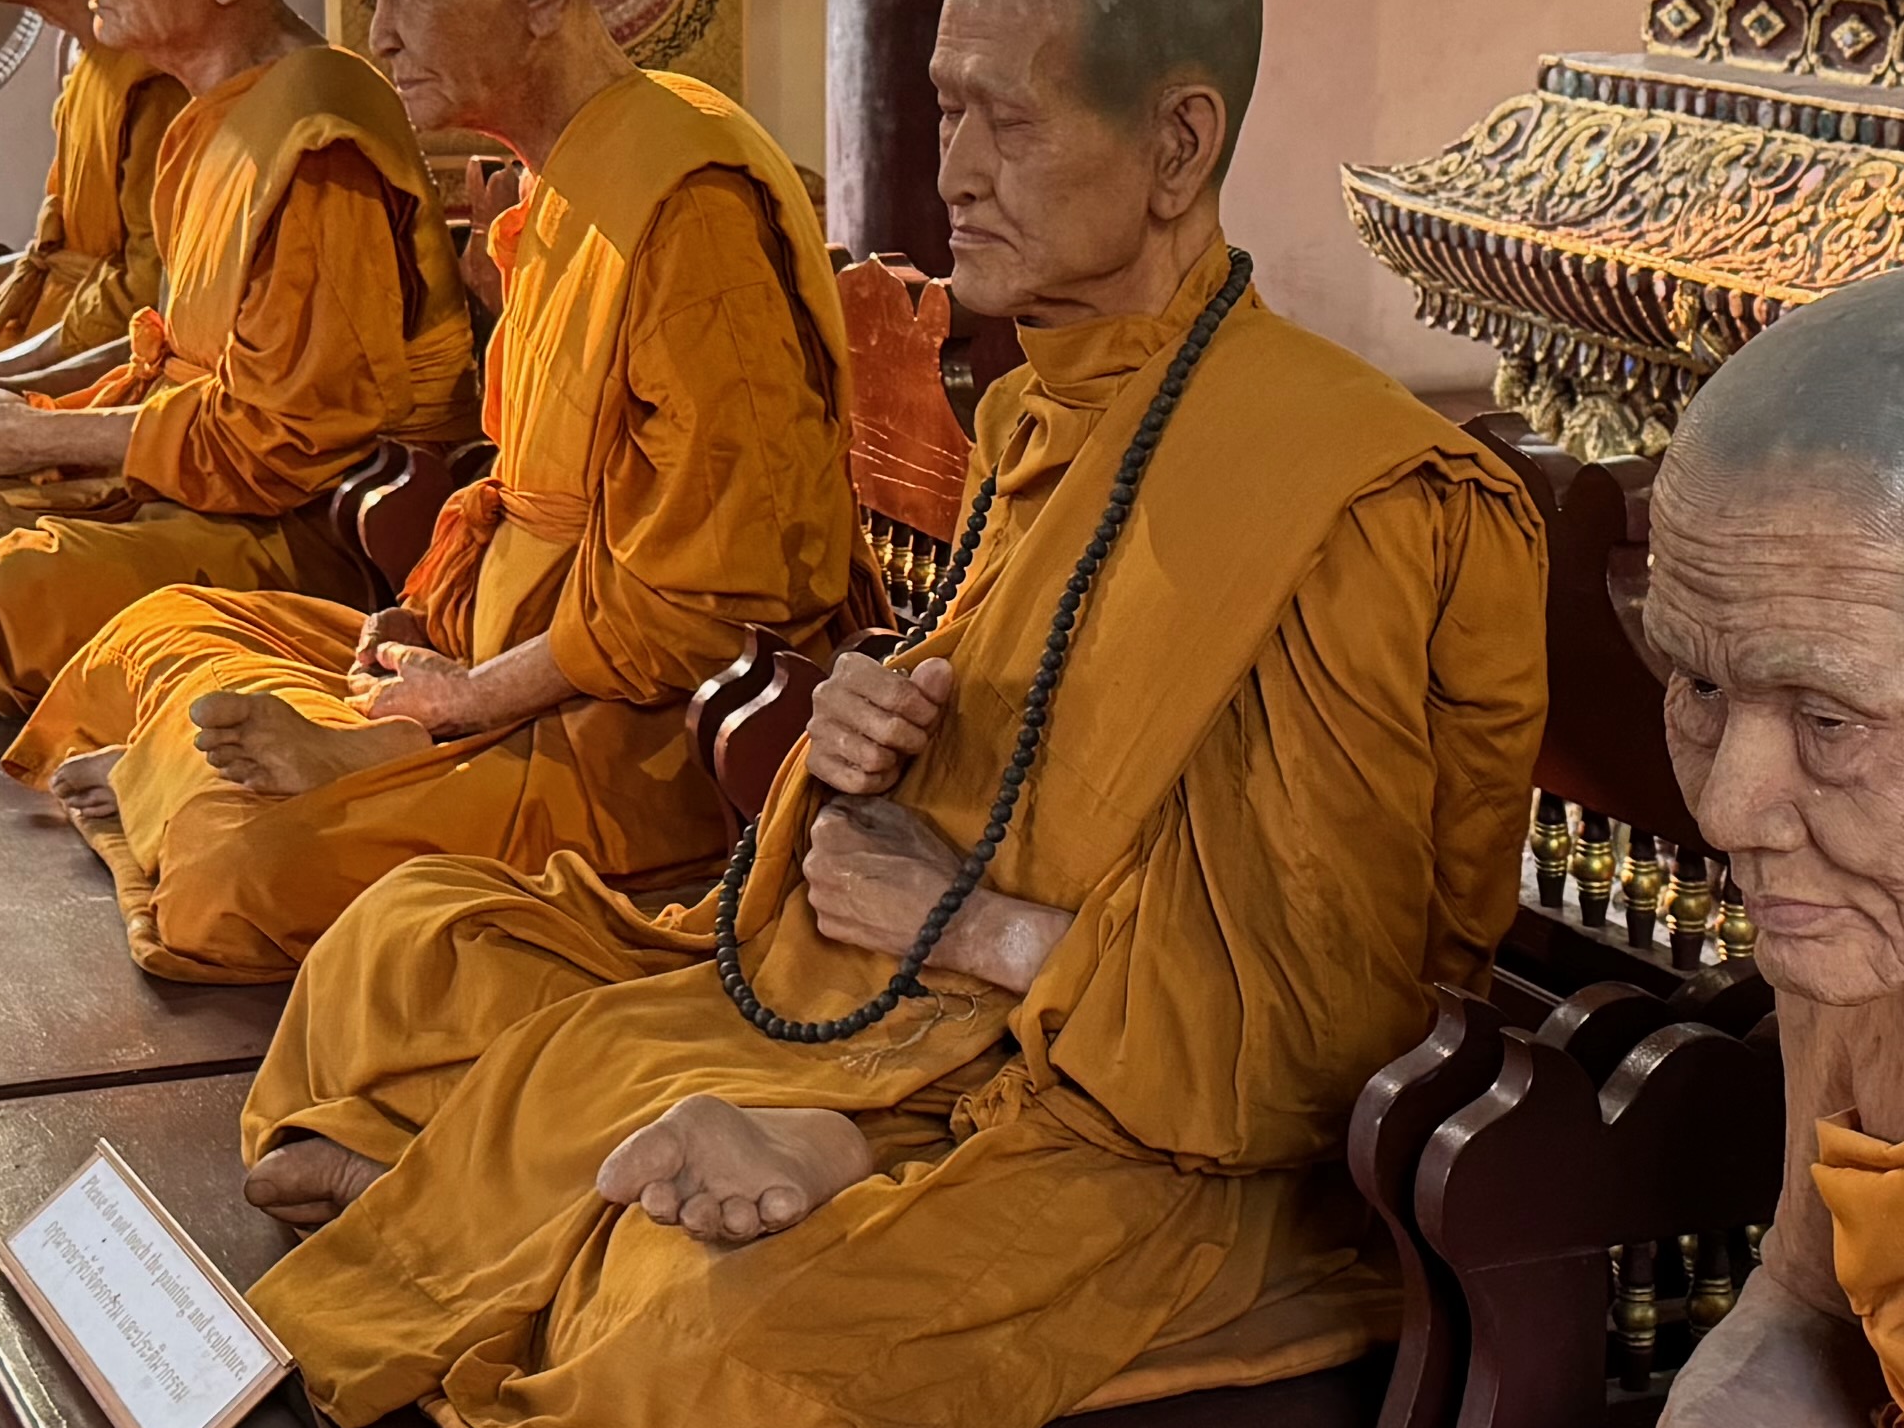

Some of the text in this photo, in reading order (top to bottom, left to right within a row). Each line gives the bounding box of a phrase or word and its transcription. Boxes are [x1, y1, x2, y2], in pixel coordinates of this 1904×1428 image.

[81, 1175, 247, 1381] Please do not touch the painting and sculpture.
